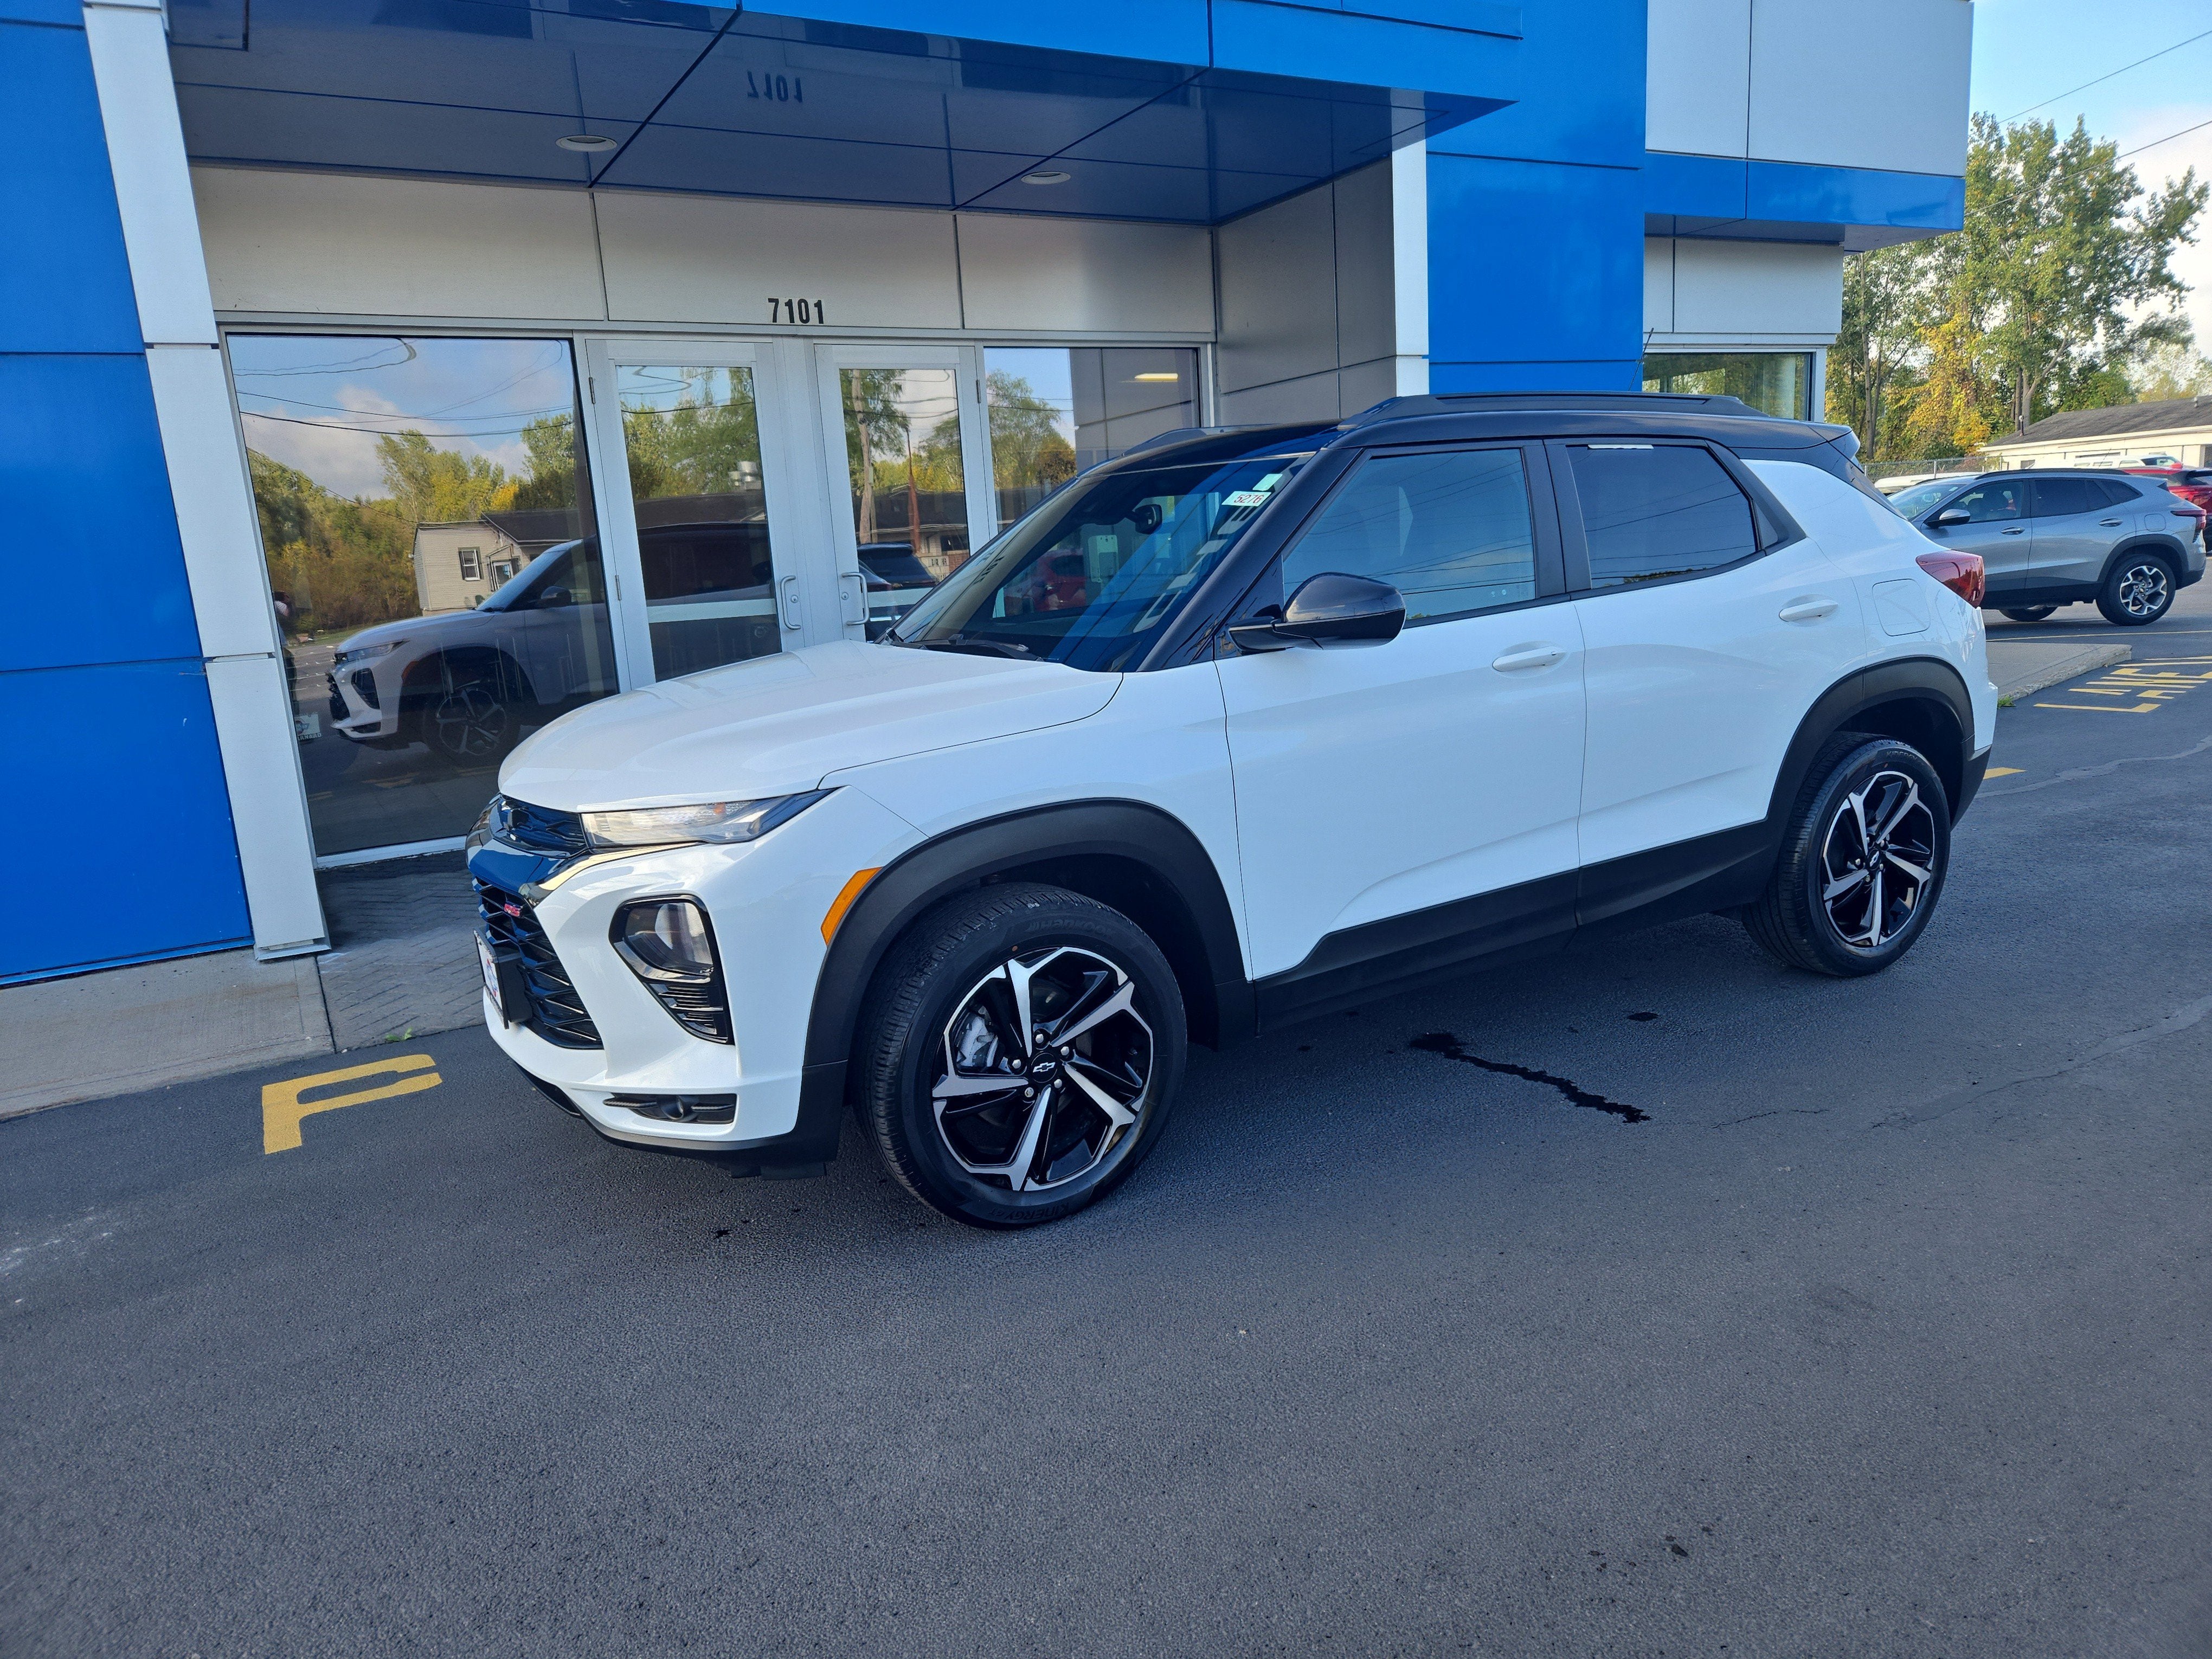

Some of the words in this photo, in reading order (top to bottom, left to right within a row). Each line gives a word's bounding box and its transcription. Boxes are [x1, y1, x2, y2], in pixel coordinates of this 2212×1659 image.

[768, 298, 824, 324] 7101
[1233, 494, 1264, 504] 5276
[2033, 668, 2212, 713] LANE
